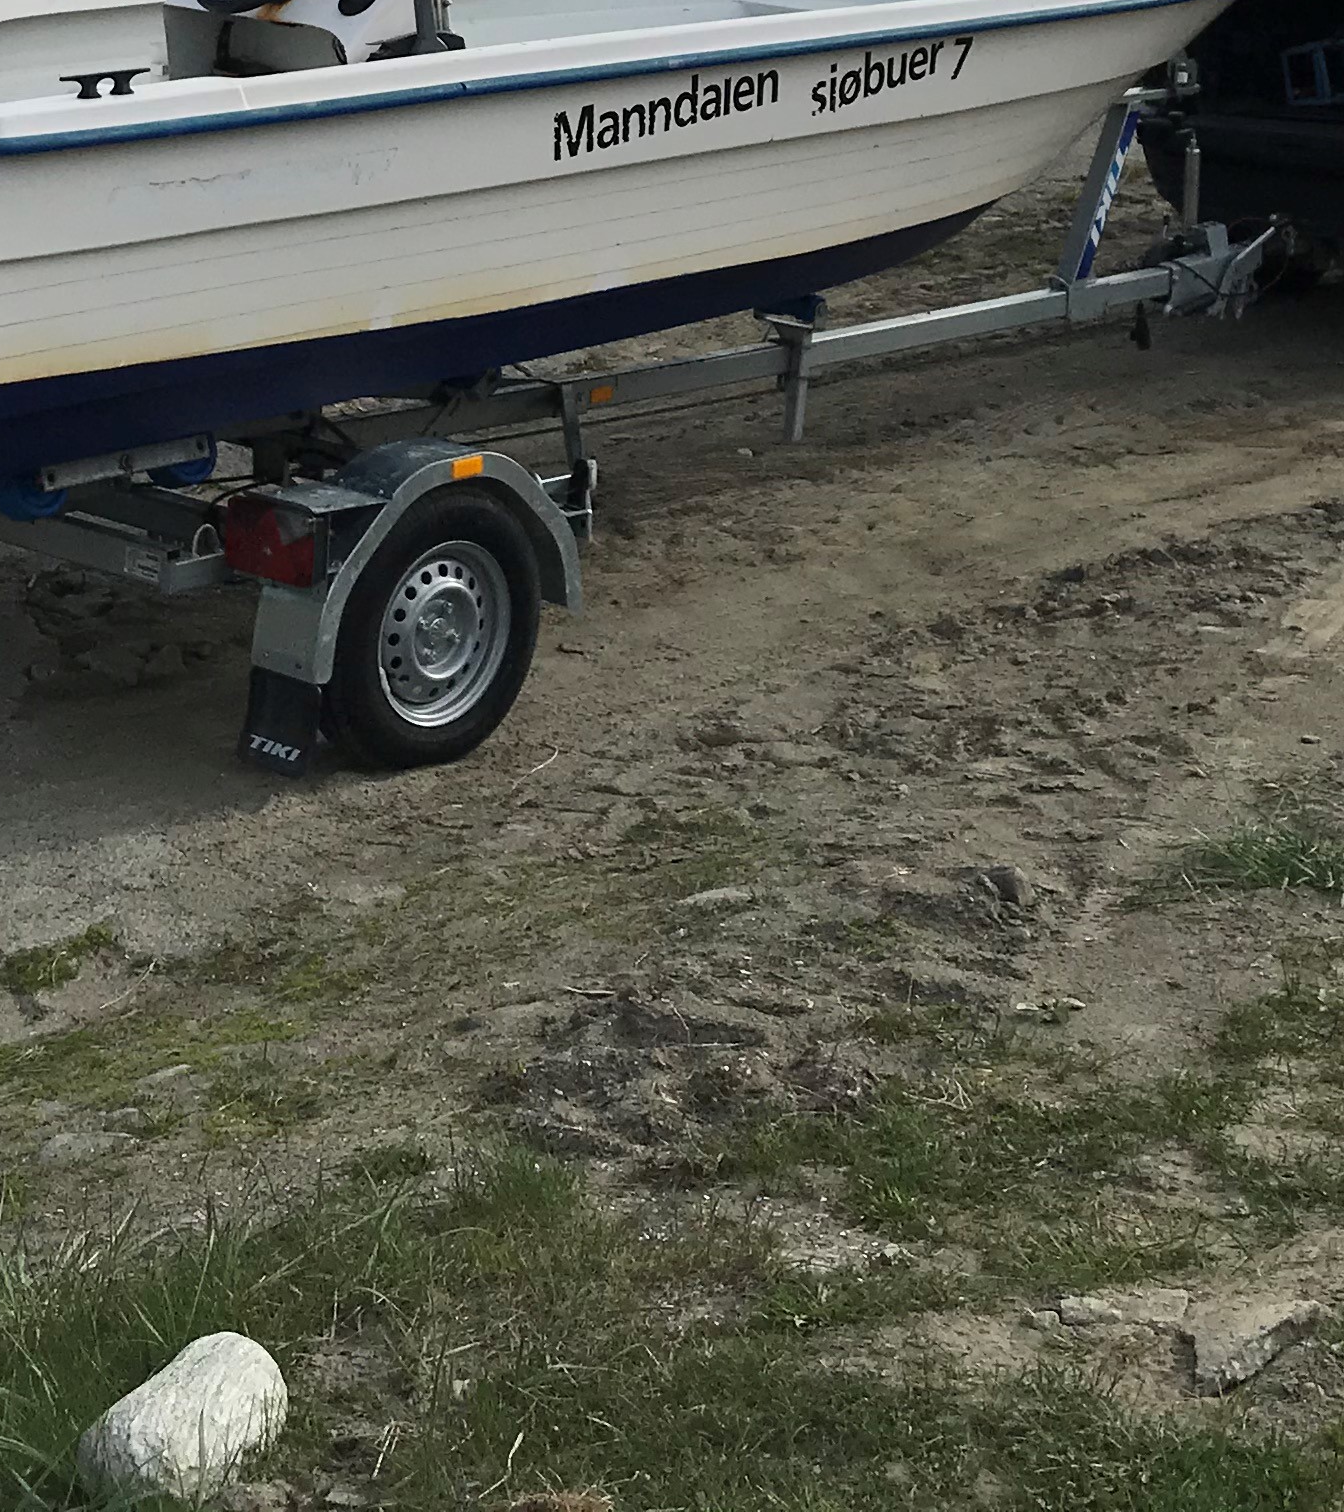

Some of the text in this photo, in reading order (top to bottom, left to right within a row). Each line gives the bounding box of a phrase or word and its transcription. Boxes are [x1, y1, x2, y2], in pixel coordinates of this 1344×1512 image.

[553, 73, 779, 161] Manndalen
[951, 36, 974, 80] 7
[249, 734, 301, 762] TIKI
